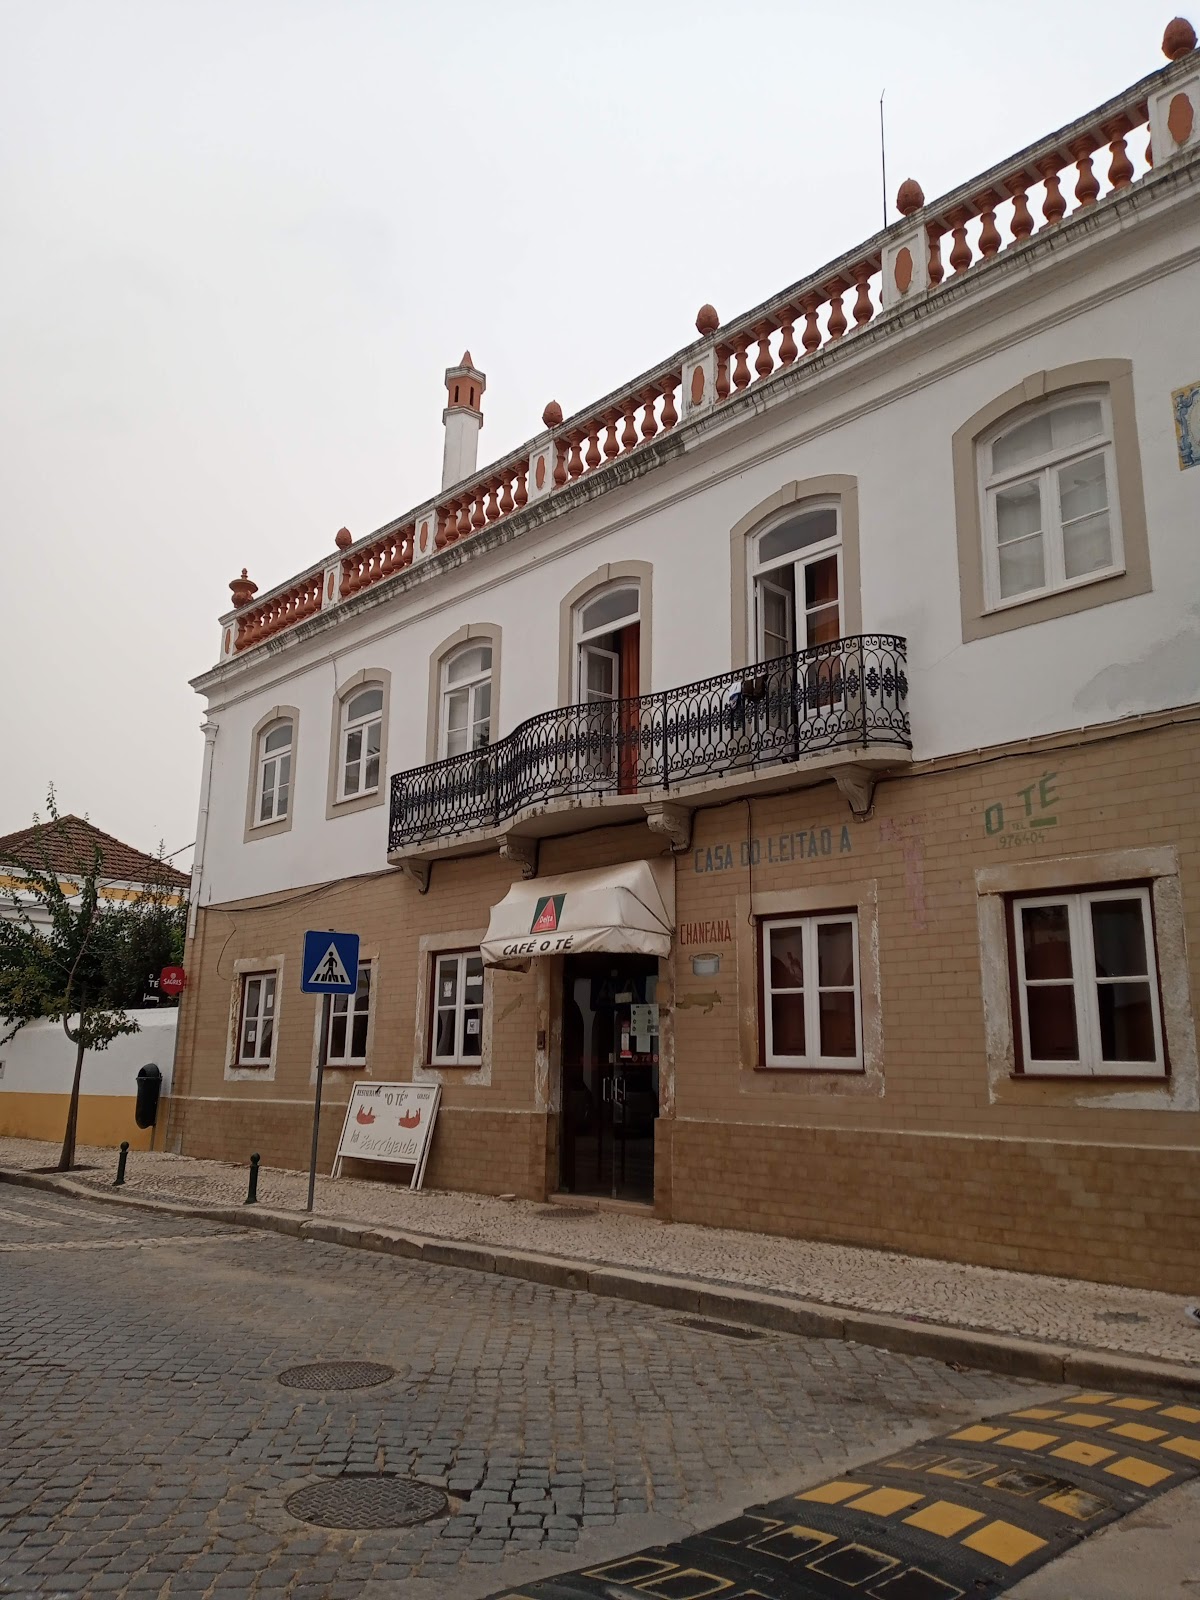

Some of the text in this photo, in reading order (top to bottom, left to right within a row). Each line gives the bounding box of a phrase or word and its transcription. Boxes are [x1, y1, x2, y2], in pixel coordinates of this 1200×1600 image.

[984, 770, 1060, 835] O TÉ
[694, 843, 734, 874] CASA
[740, 838, 761, 867] DO
[840, 825, 852, 853] A
[502, 934, 574, 956] CAFÉ O TÉ
[680, 919, 732, 946] CHANFANA
[149, 978, 160, 987] TÉ
